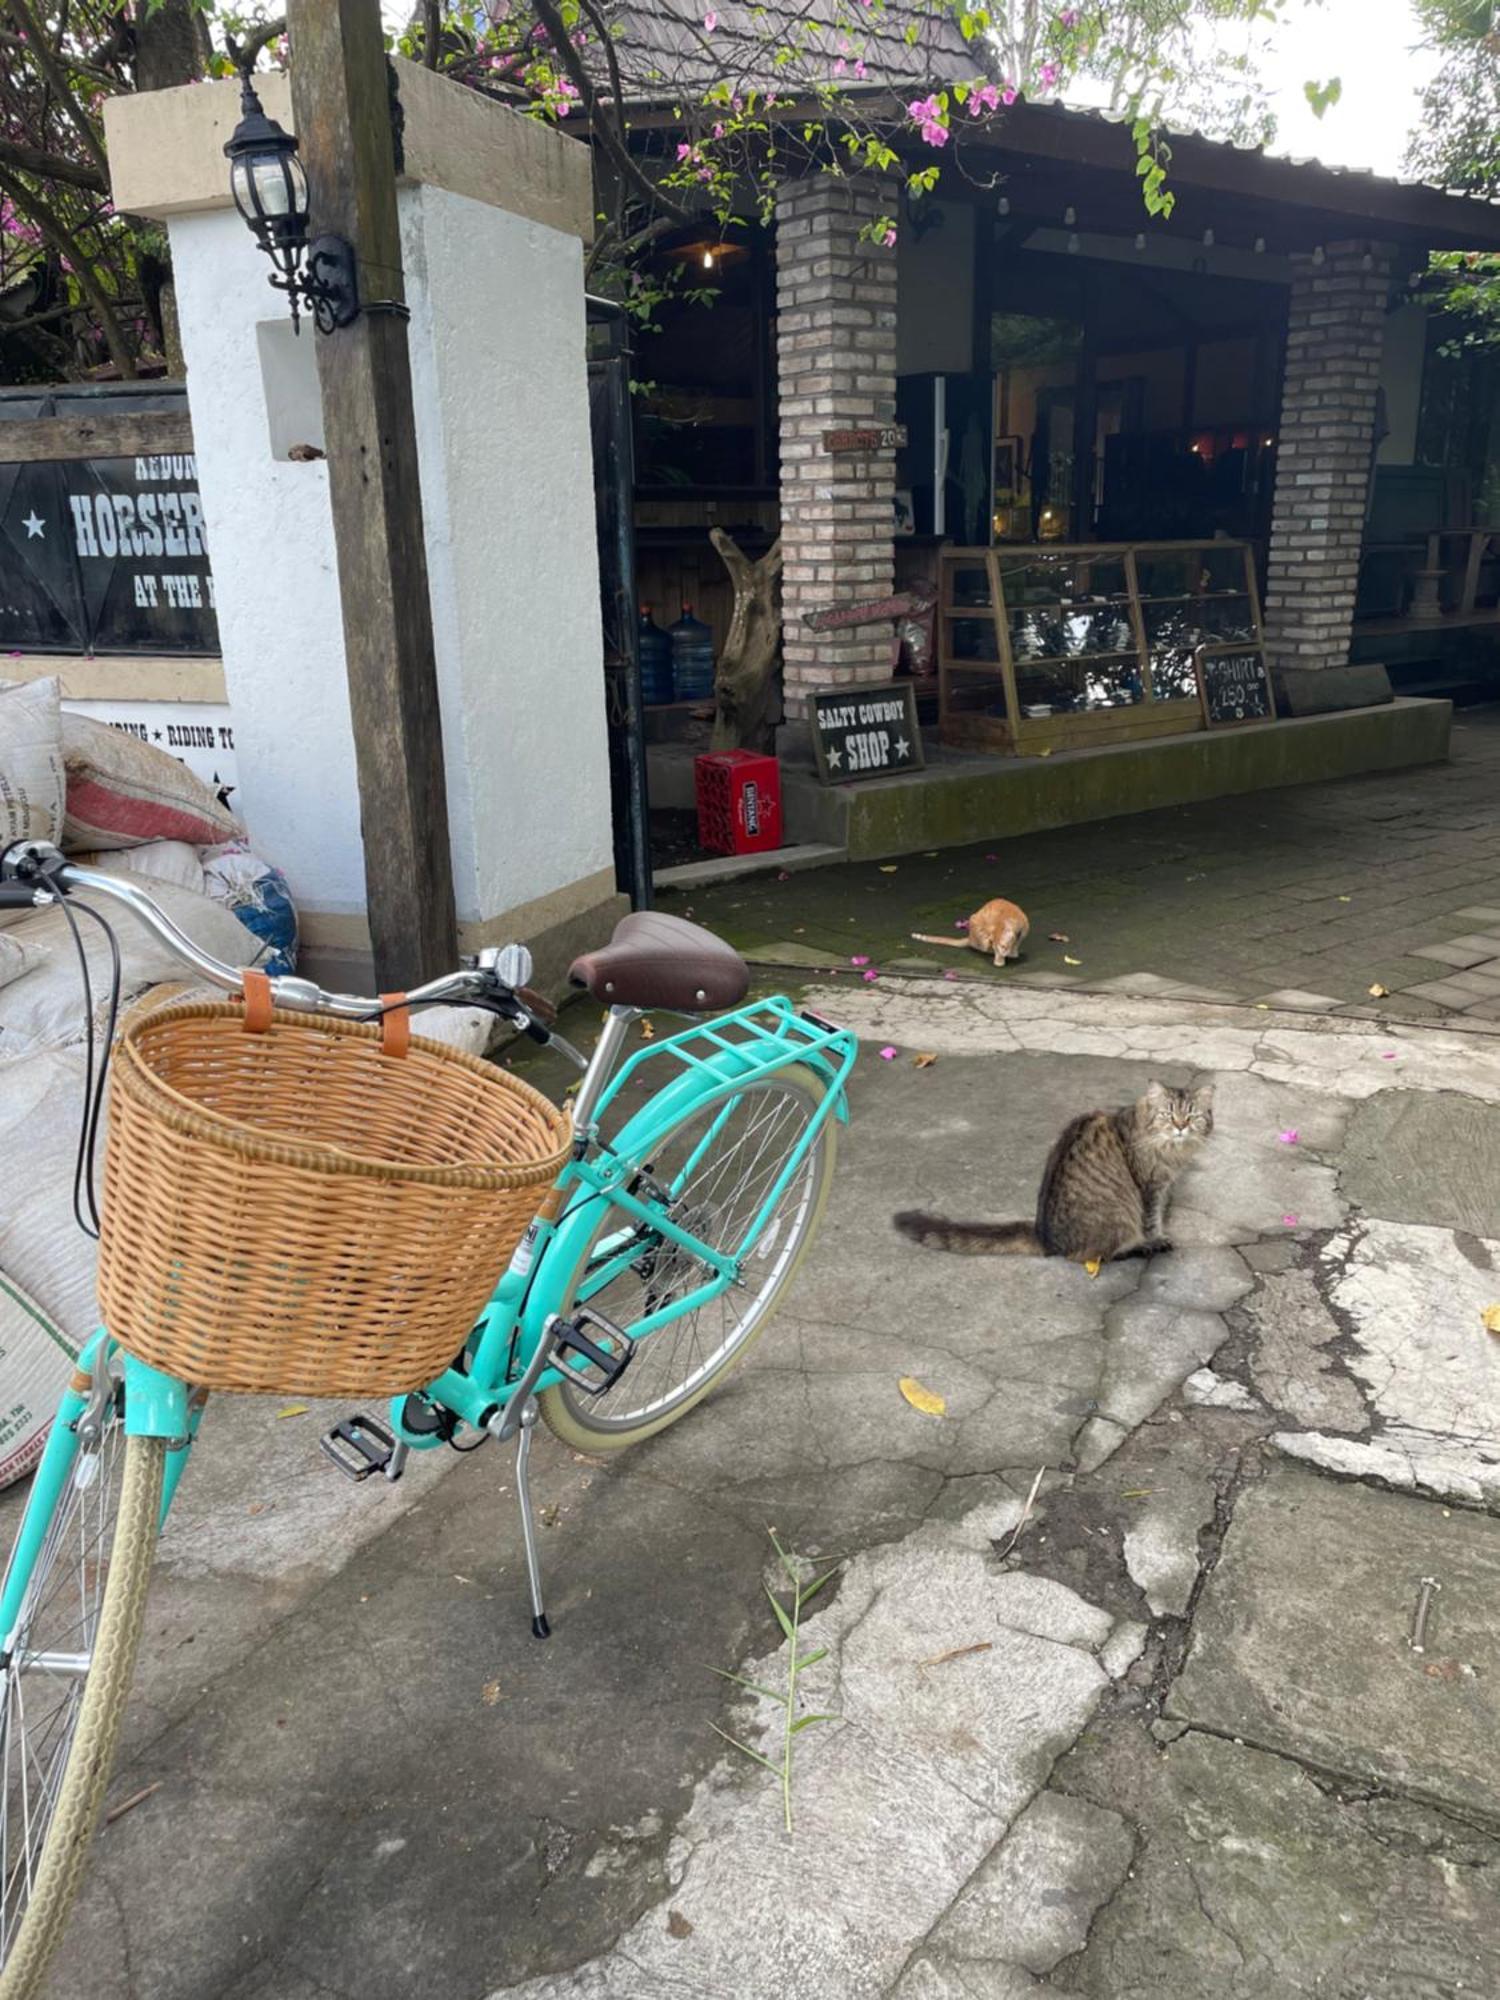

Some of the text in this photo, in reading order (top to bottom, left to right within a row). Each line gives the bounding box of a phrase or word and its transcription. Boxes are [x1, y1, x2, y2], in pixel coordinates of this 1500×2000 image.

[134, 575, 158, 607] AT
[161, 575, 202, 608] THE
[817, 700, 904, 730] SALTY COWBOY
[167, 725, 215, 749] RIDING
[845, 731, 889, 770] SHOP
